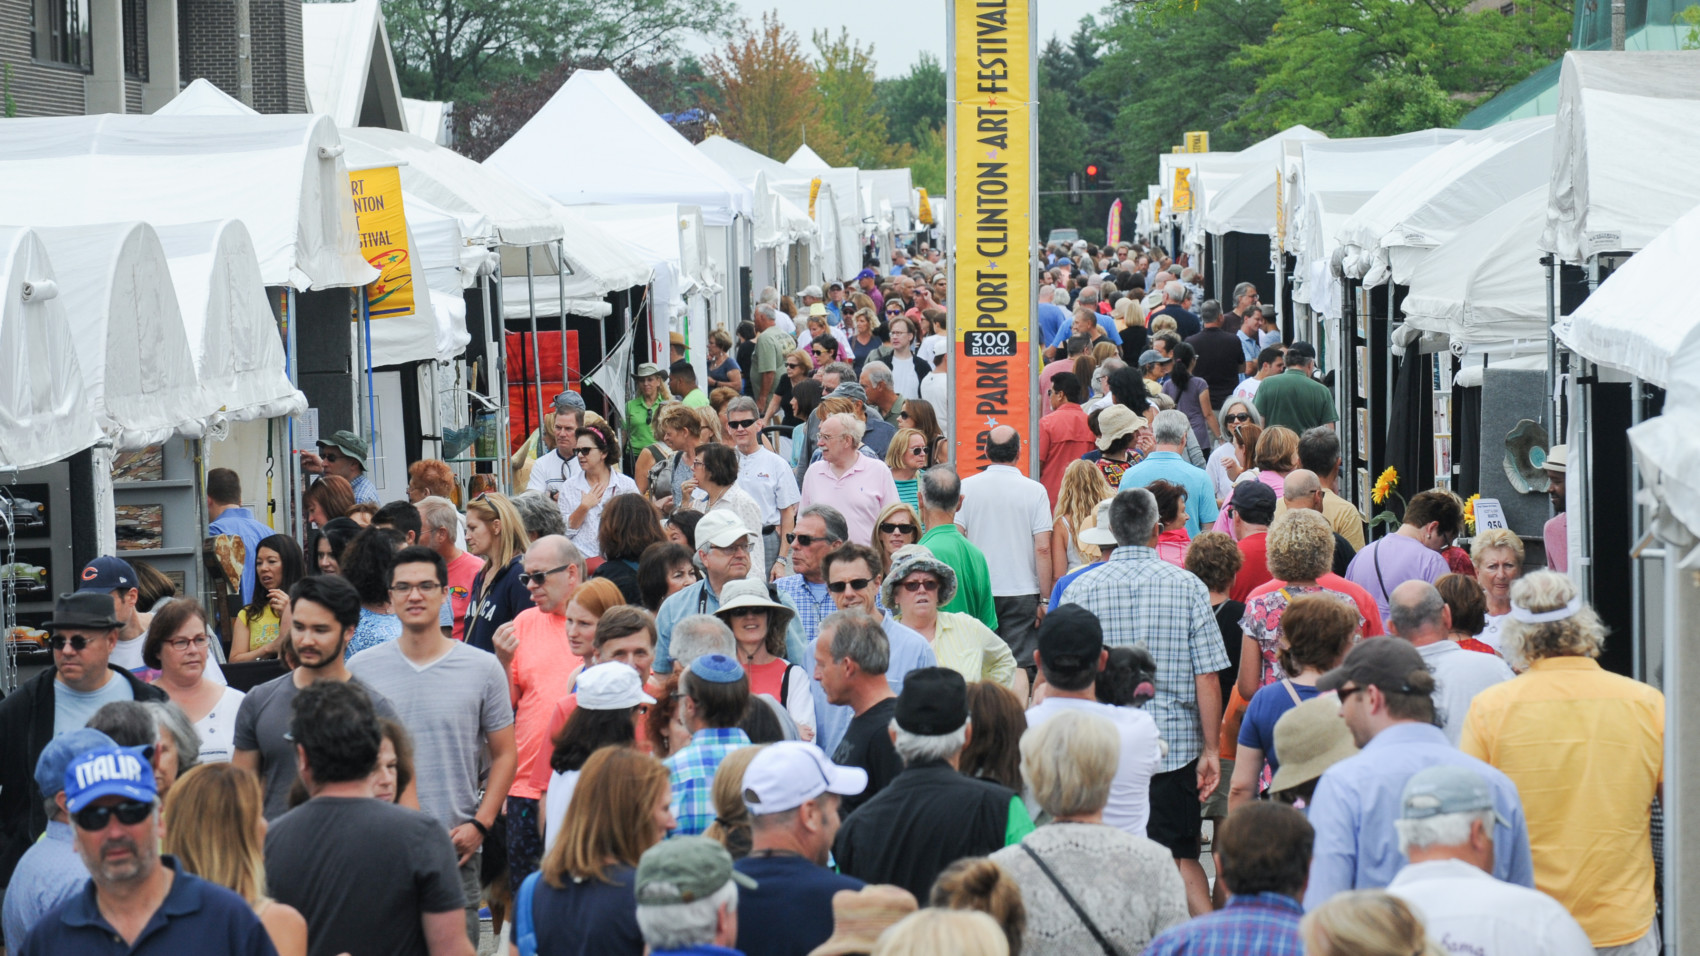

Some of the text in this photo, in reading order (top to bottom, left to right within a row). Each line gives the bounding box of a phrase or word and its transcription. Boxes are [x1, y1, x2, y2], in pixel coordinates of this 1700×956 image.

[976, 0, 1008, 329] PORT CLINTON ART FESTIVAL
[971, 332, 1010, 347] 300
[972, 346, 1010, 356] BLOCK
[976, 360, 1008, 415] PARK
[82, 566, 99, 581] C
[75, 754, 142, 789] ITALIA
